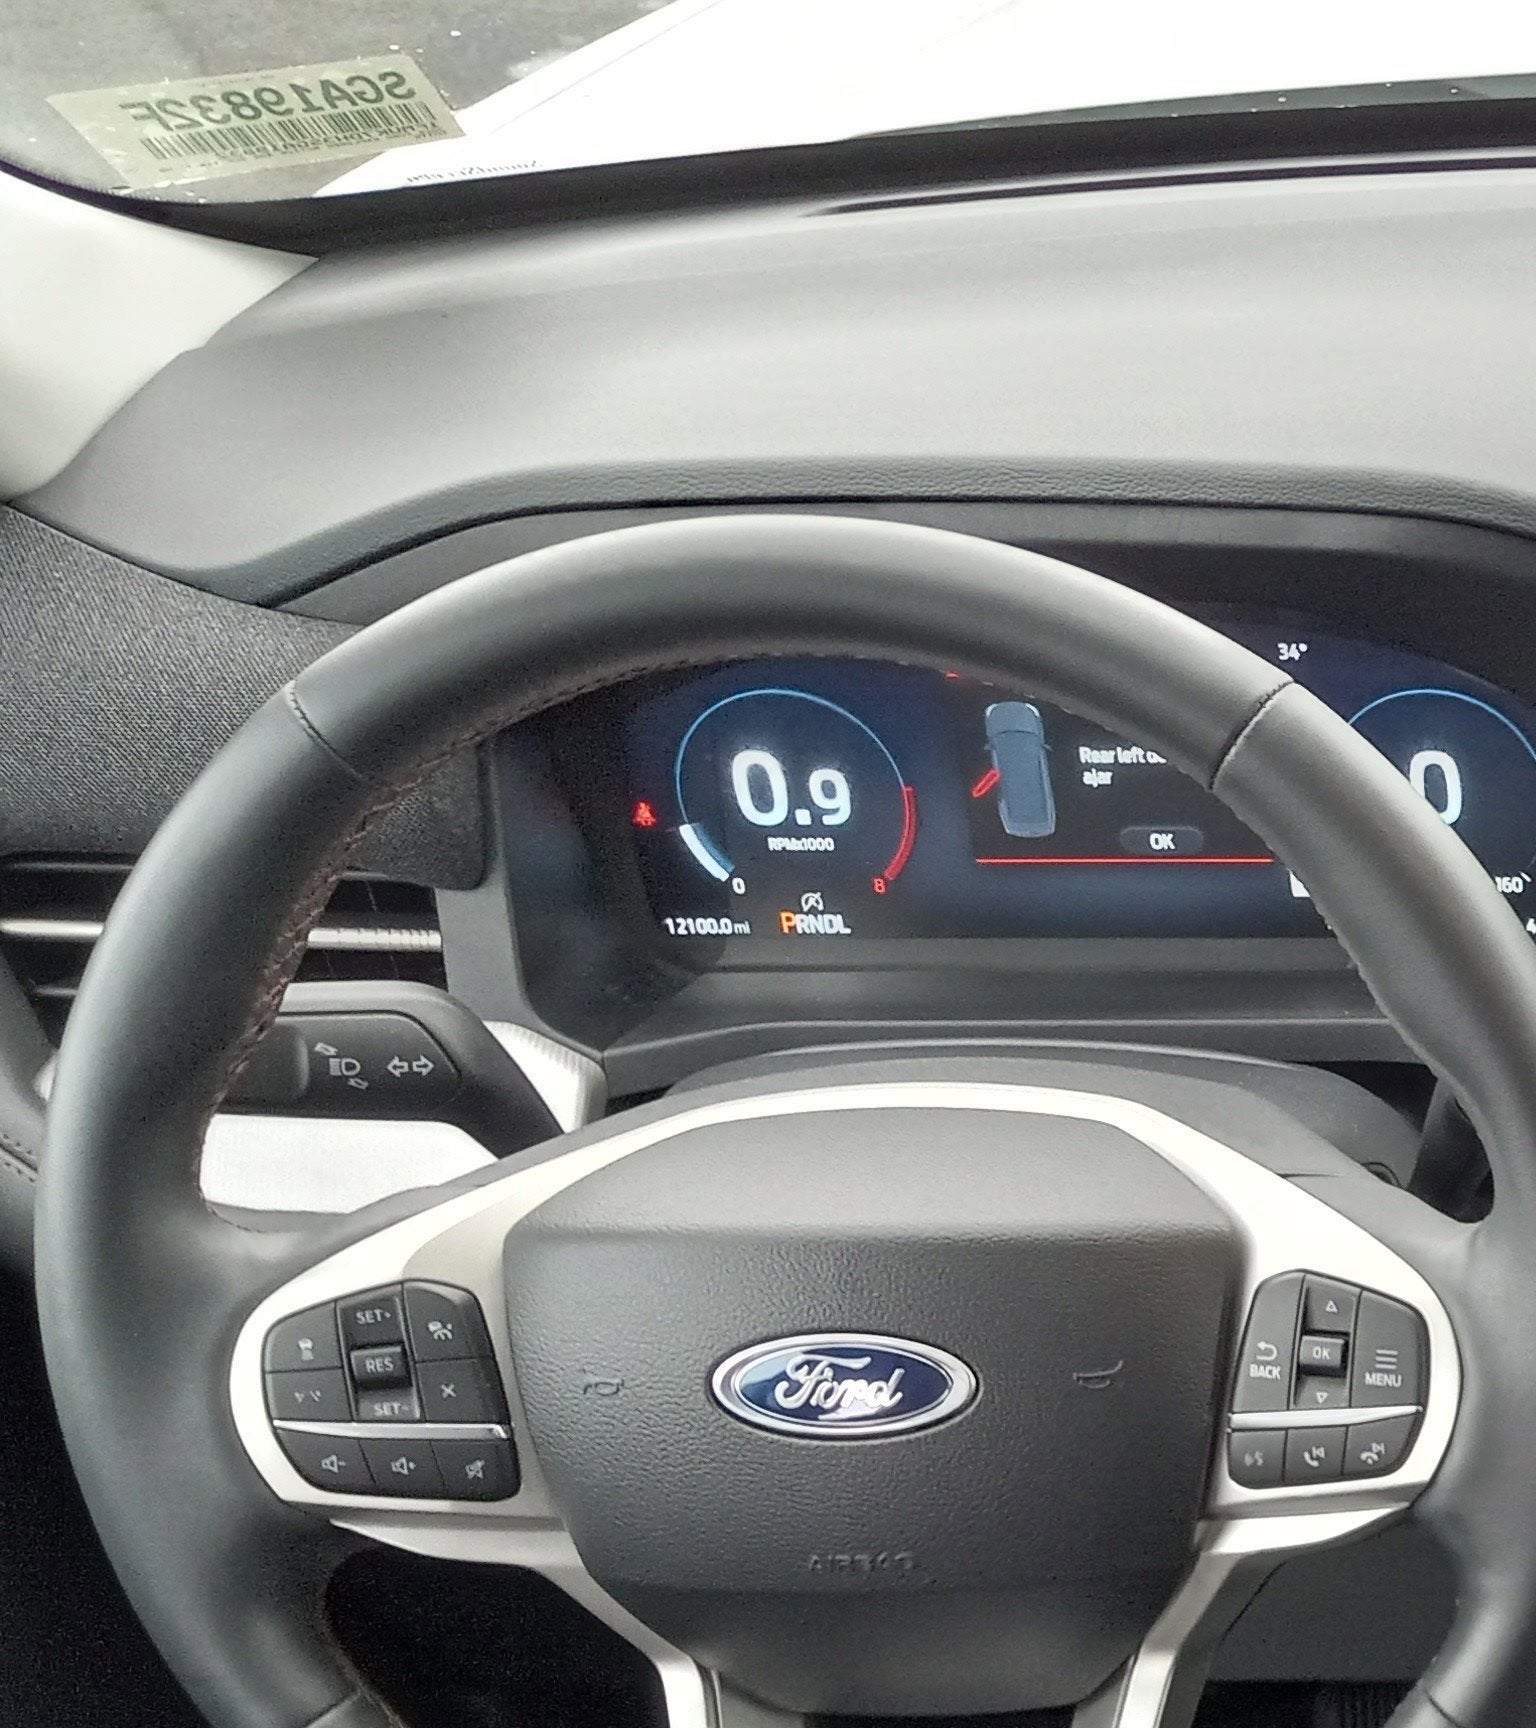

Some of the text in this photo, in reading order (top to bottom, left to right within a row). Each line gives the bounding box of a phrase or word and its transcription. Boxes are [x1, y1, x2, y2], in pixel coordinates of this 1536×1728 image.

[1078, 746, 1115, 764] Rear
[1116, 746, 1146, 764] left
[1082, 768, 1113, 788] ajar
[729, 748, 852, 827] 0.9
[1149, 832, 1176, 850] OK
[731, 877, 746, 895] 0
[872, 878, 886, 894] 8
[365, 1356, 394, 1373] RES
[1250, 1364, 1281, 1380] BACK
[775, 1353, 904, 1410] Ford
[1365, 1372, 1402, 1388] MENU
